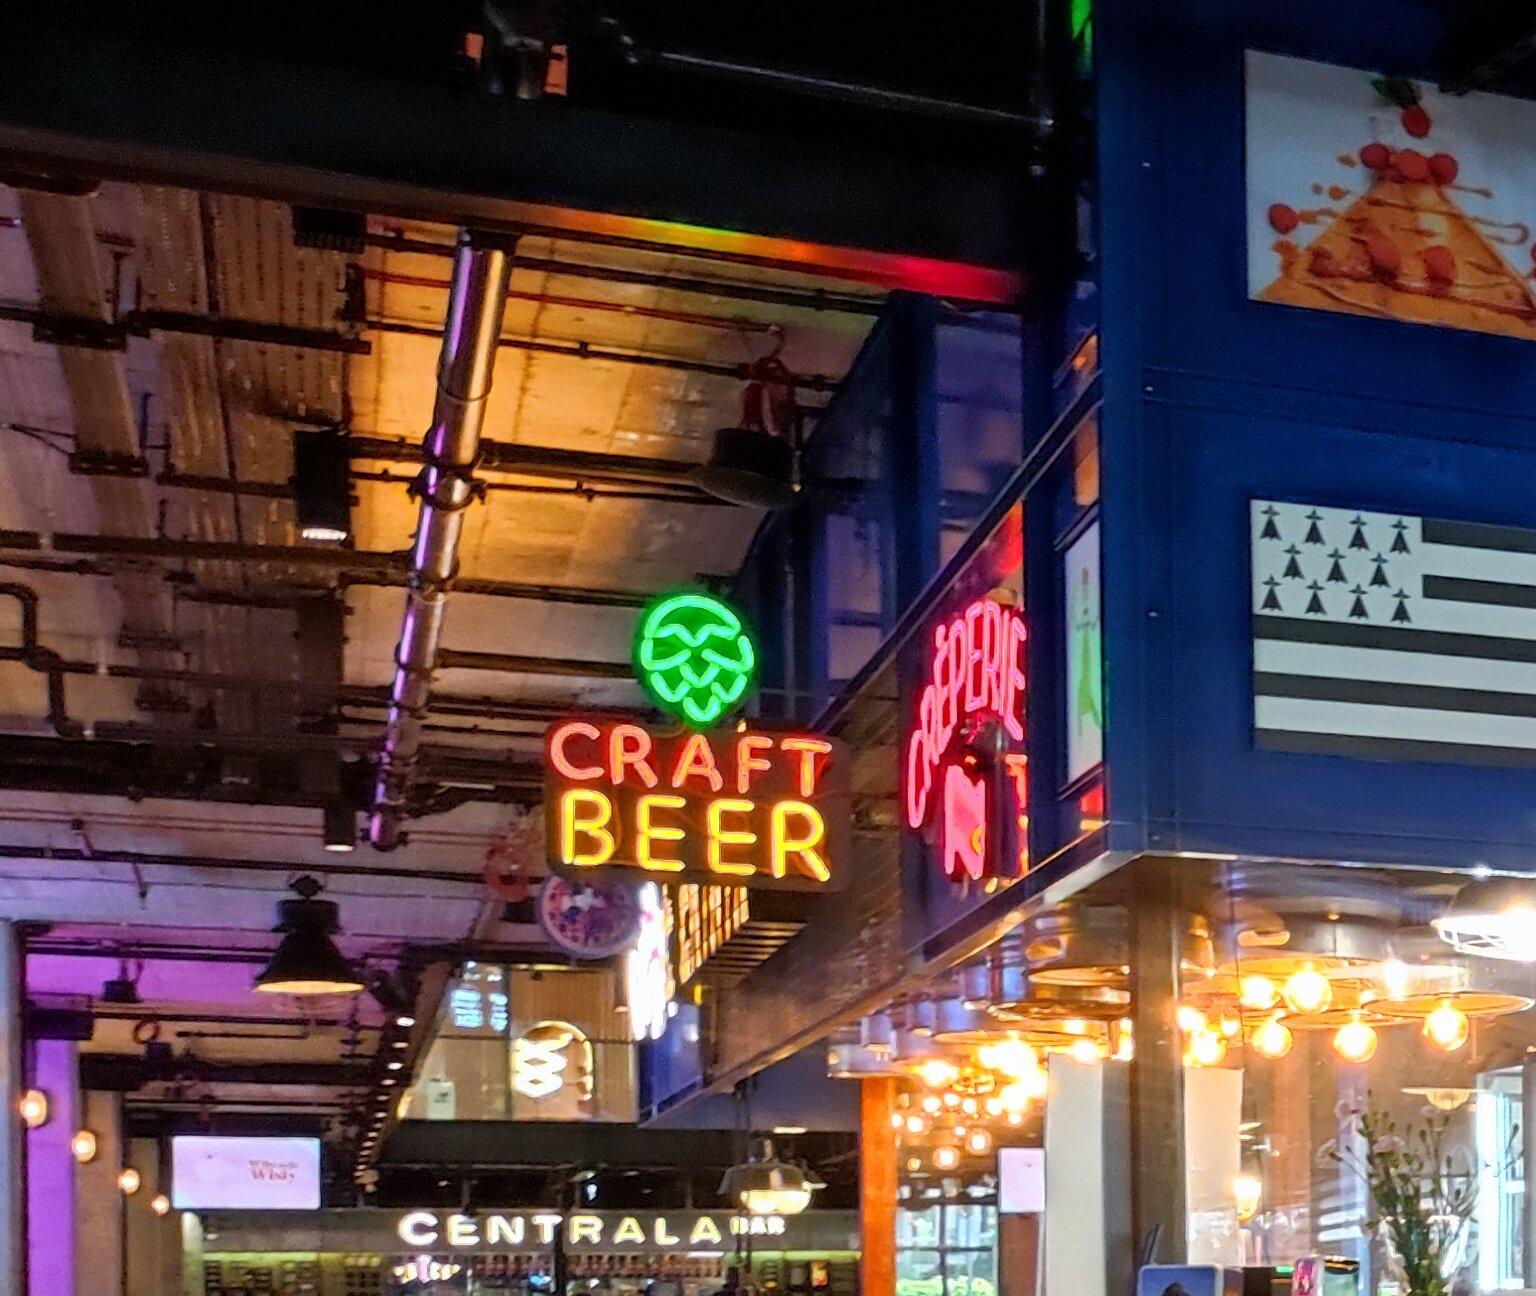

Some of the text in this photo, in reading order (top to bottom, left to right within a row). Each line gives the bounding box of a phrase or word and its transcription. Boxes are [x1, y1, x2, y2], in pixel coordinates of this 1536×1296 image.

[548, 721, 833, 797] CRAFT
[559, 788, 831, 882] BEER
[397, 1211, 787, 1246] CENTRALA BAR
